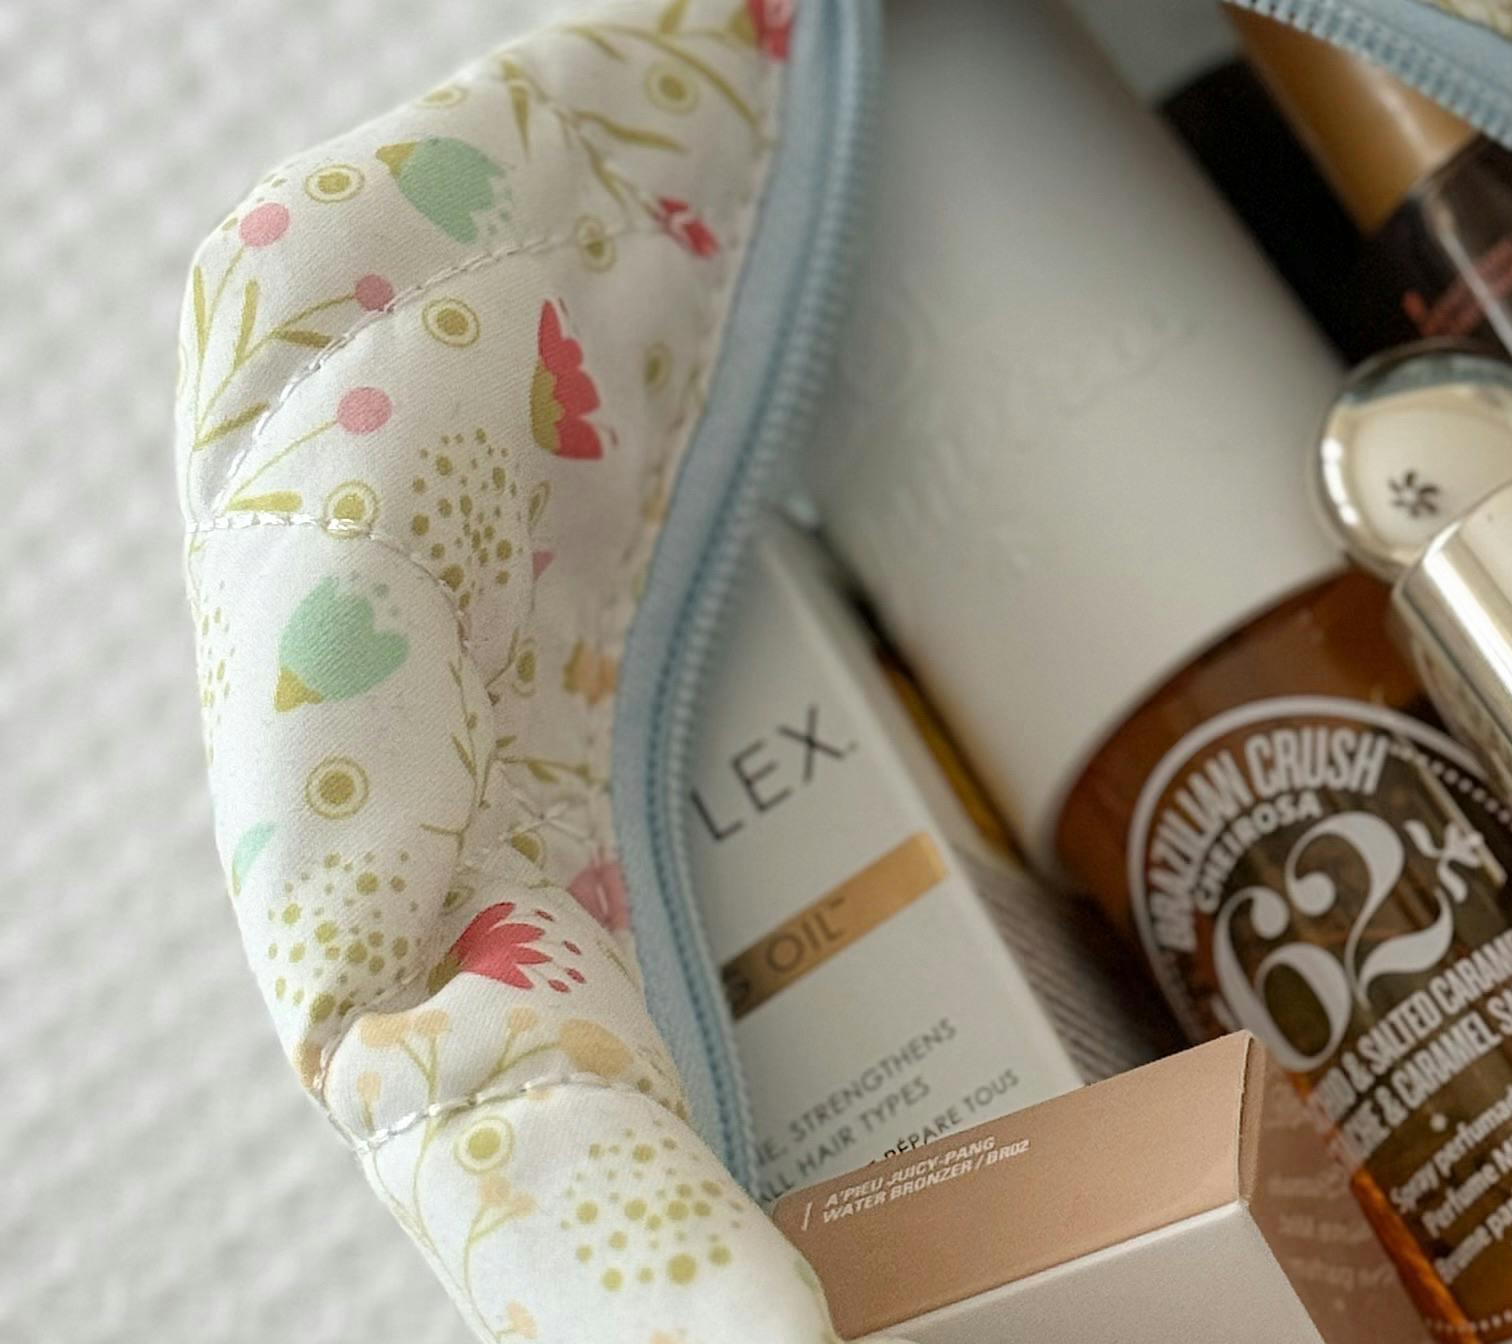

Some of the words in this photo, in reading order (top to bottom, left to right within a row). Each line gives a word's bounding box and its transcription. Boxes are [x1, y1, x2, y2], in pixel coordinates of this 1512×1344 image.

[1149, 748, 1255, 952] BRAZILIAN
[1244, 725, 1390, 799] CRUSH
[1196, 790, 1324, 915] CHEIROSA
[1212, 810, 1454, 1073] 62
[788, 1016, 957, 1143] STRENGTHENS
[1356, 990, 1442, 1076] SALTED
[1391, 1011, 1503, 1109] CARAMEL
[796, 1127, 855, 1177] HAIR
[860, 1074, 931, 1133] TYPES
[963, 1067, 1019, 1113] TOUS
[821, 1192, 887, 1224] WATER
[889, 1161, 973, 1201] BRONZER
[1389, 1160, 1440, 1215] Spray
[1421, 1162, 1501, 1239] Perfume
